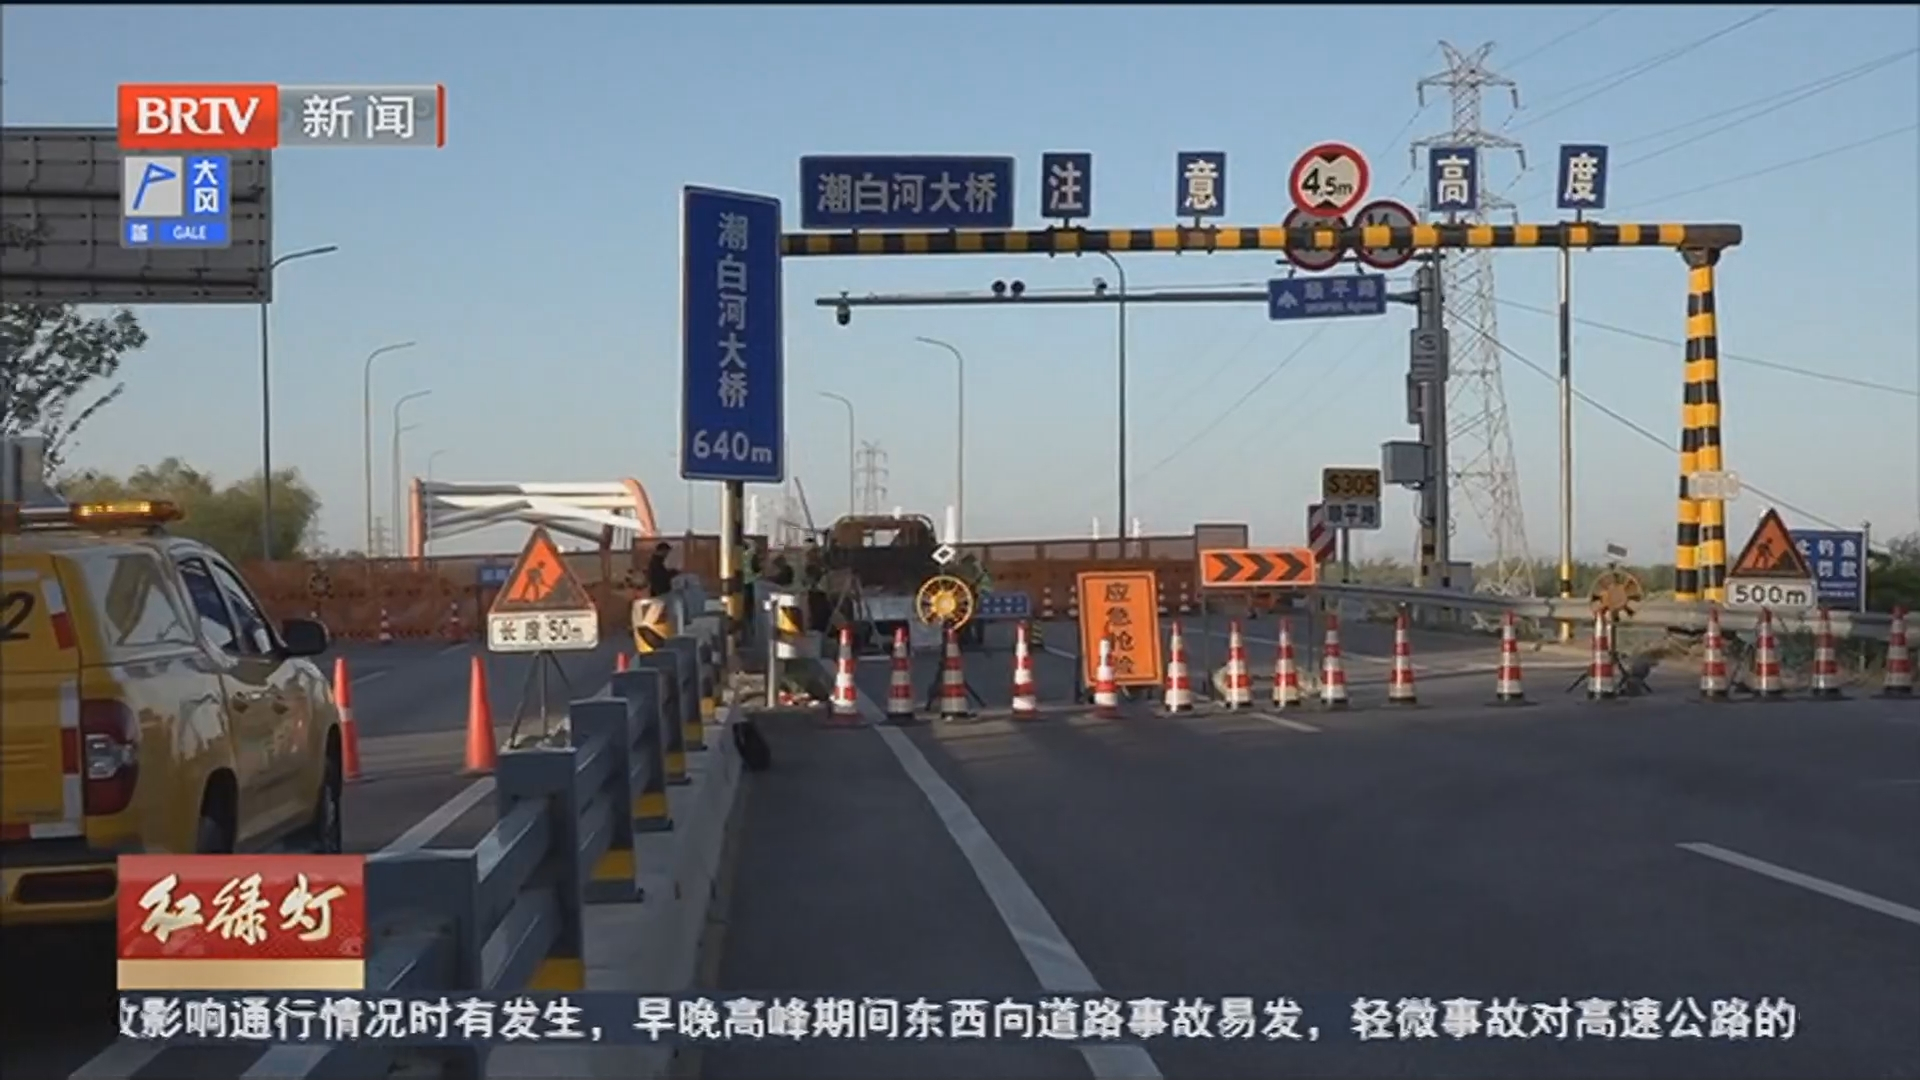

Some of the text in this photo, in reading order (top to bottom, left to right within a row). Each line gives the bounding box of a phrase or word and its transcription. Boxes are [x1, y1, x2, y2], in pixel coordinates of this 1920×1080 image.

[817, 172, 998, 214] 潮白河大桥
[1049, 152, 1599, 211] 注 意 高 度
[1301, 167, 1353, 197] 4.5m
[716, 211, 749, 409] 潮白河大桥
[692, 430, 773, 463] 640m
[1328, 473, 1376, 494] S305
[1735, 584, 1806, 604] 500m
